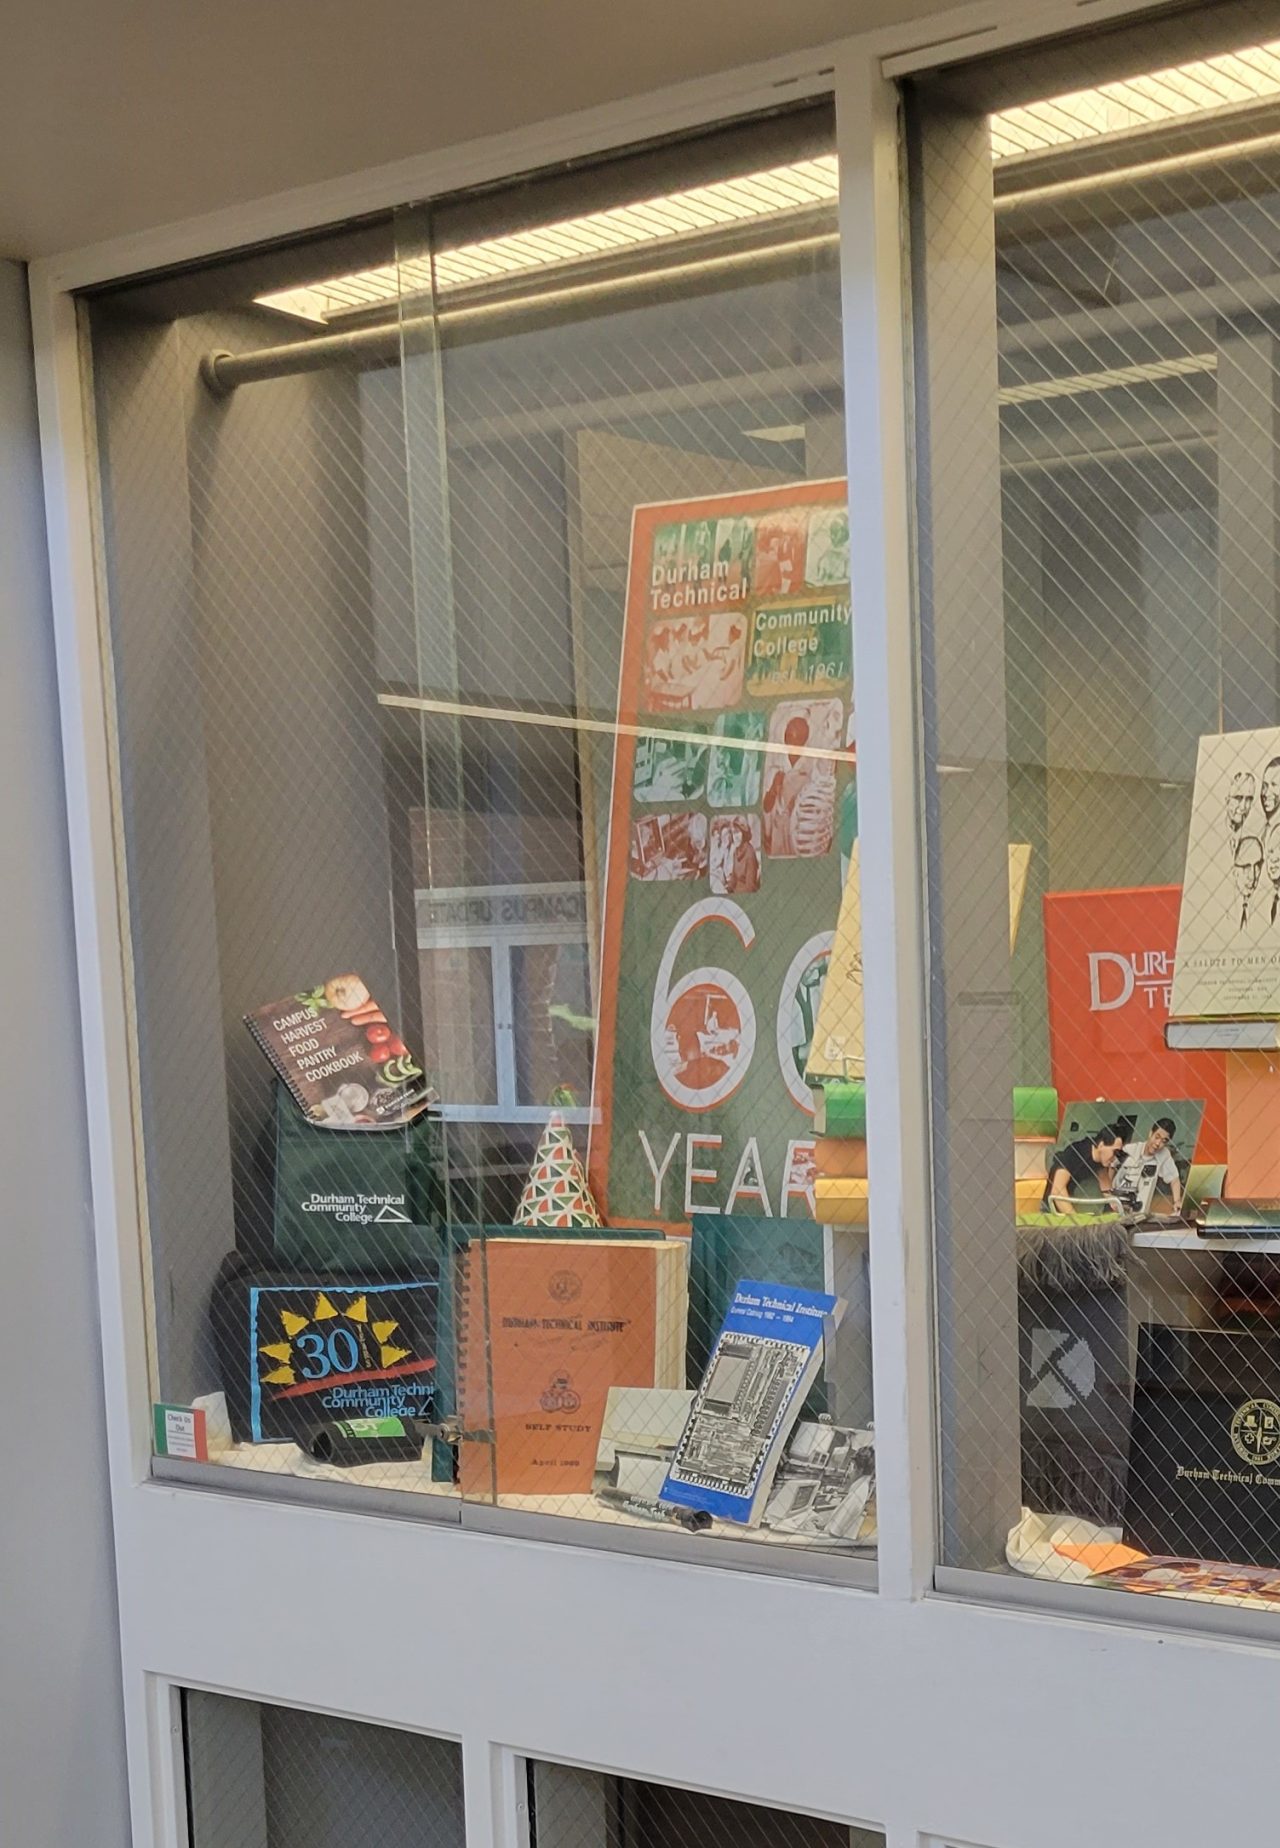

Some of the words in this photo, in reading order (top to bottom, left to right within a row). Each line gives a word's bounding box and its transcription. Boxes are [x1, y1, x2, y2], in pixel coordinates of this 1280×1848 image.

[652, 560, 729, 586] Durham
[651, 578, 747, 610] Technical
[756, 604, 852, 631] Community
[754, 636, 818, 658] College
[1231, 958, 1243, 966] TO
[1088, 951, 1175, 1011] DURH
[273, 1006, 318, 1031] CAMPUS
[280, 1018, 327, 1044] HARVEST
[288, 1038, 320, 1057] FOOD
[297, 1045, 337, 1070] PANTRY
[305, 1051, 364, 1082] COOKBOOK
[638, 1130, 816, 1217] YEAR
[301, 1202, 367, 1214] Community
[311, 1193, 355, 1204] Durham
[357, 1194, 405, 1205] Technical
[335, 1212, 373, 1225] College
[734, 1292, 761, 1306] Durham
[762, 1296, 796, 1312] Technical
[297, 1328, 358, 1379] 30
[333, 1387, 389, 1399] Durham
[392, 1382, 434, 1397] Techni
[322, 1395, 405, 1409] Community
[365, 1401, 416, 1418] College
[525, 1423, 552, 1431] SELF
[556, 1424, 592, 1432] STUDY
[1175, 1465, 1211, 1481] Durham
[1211, 1468, 1253, 1484] Technical
